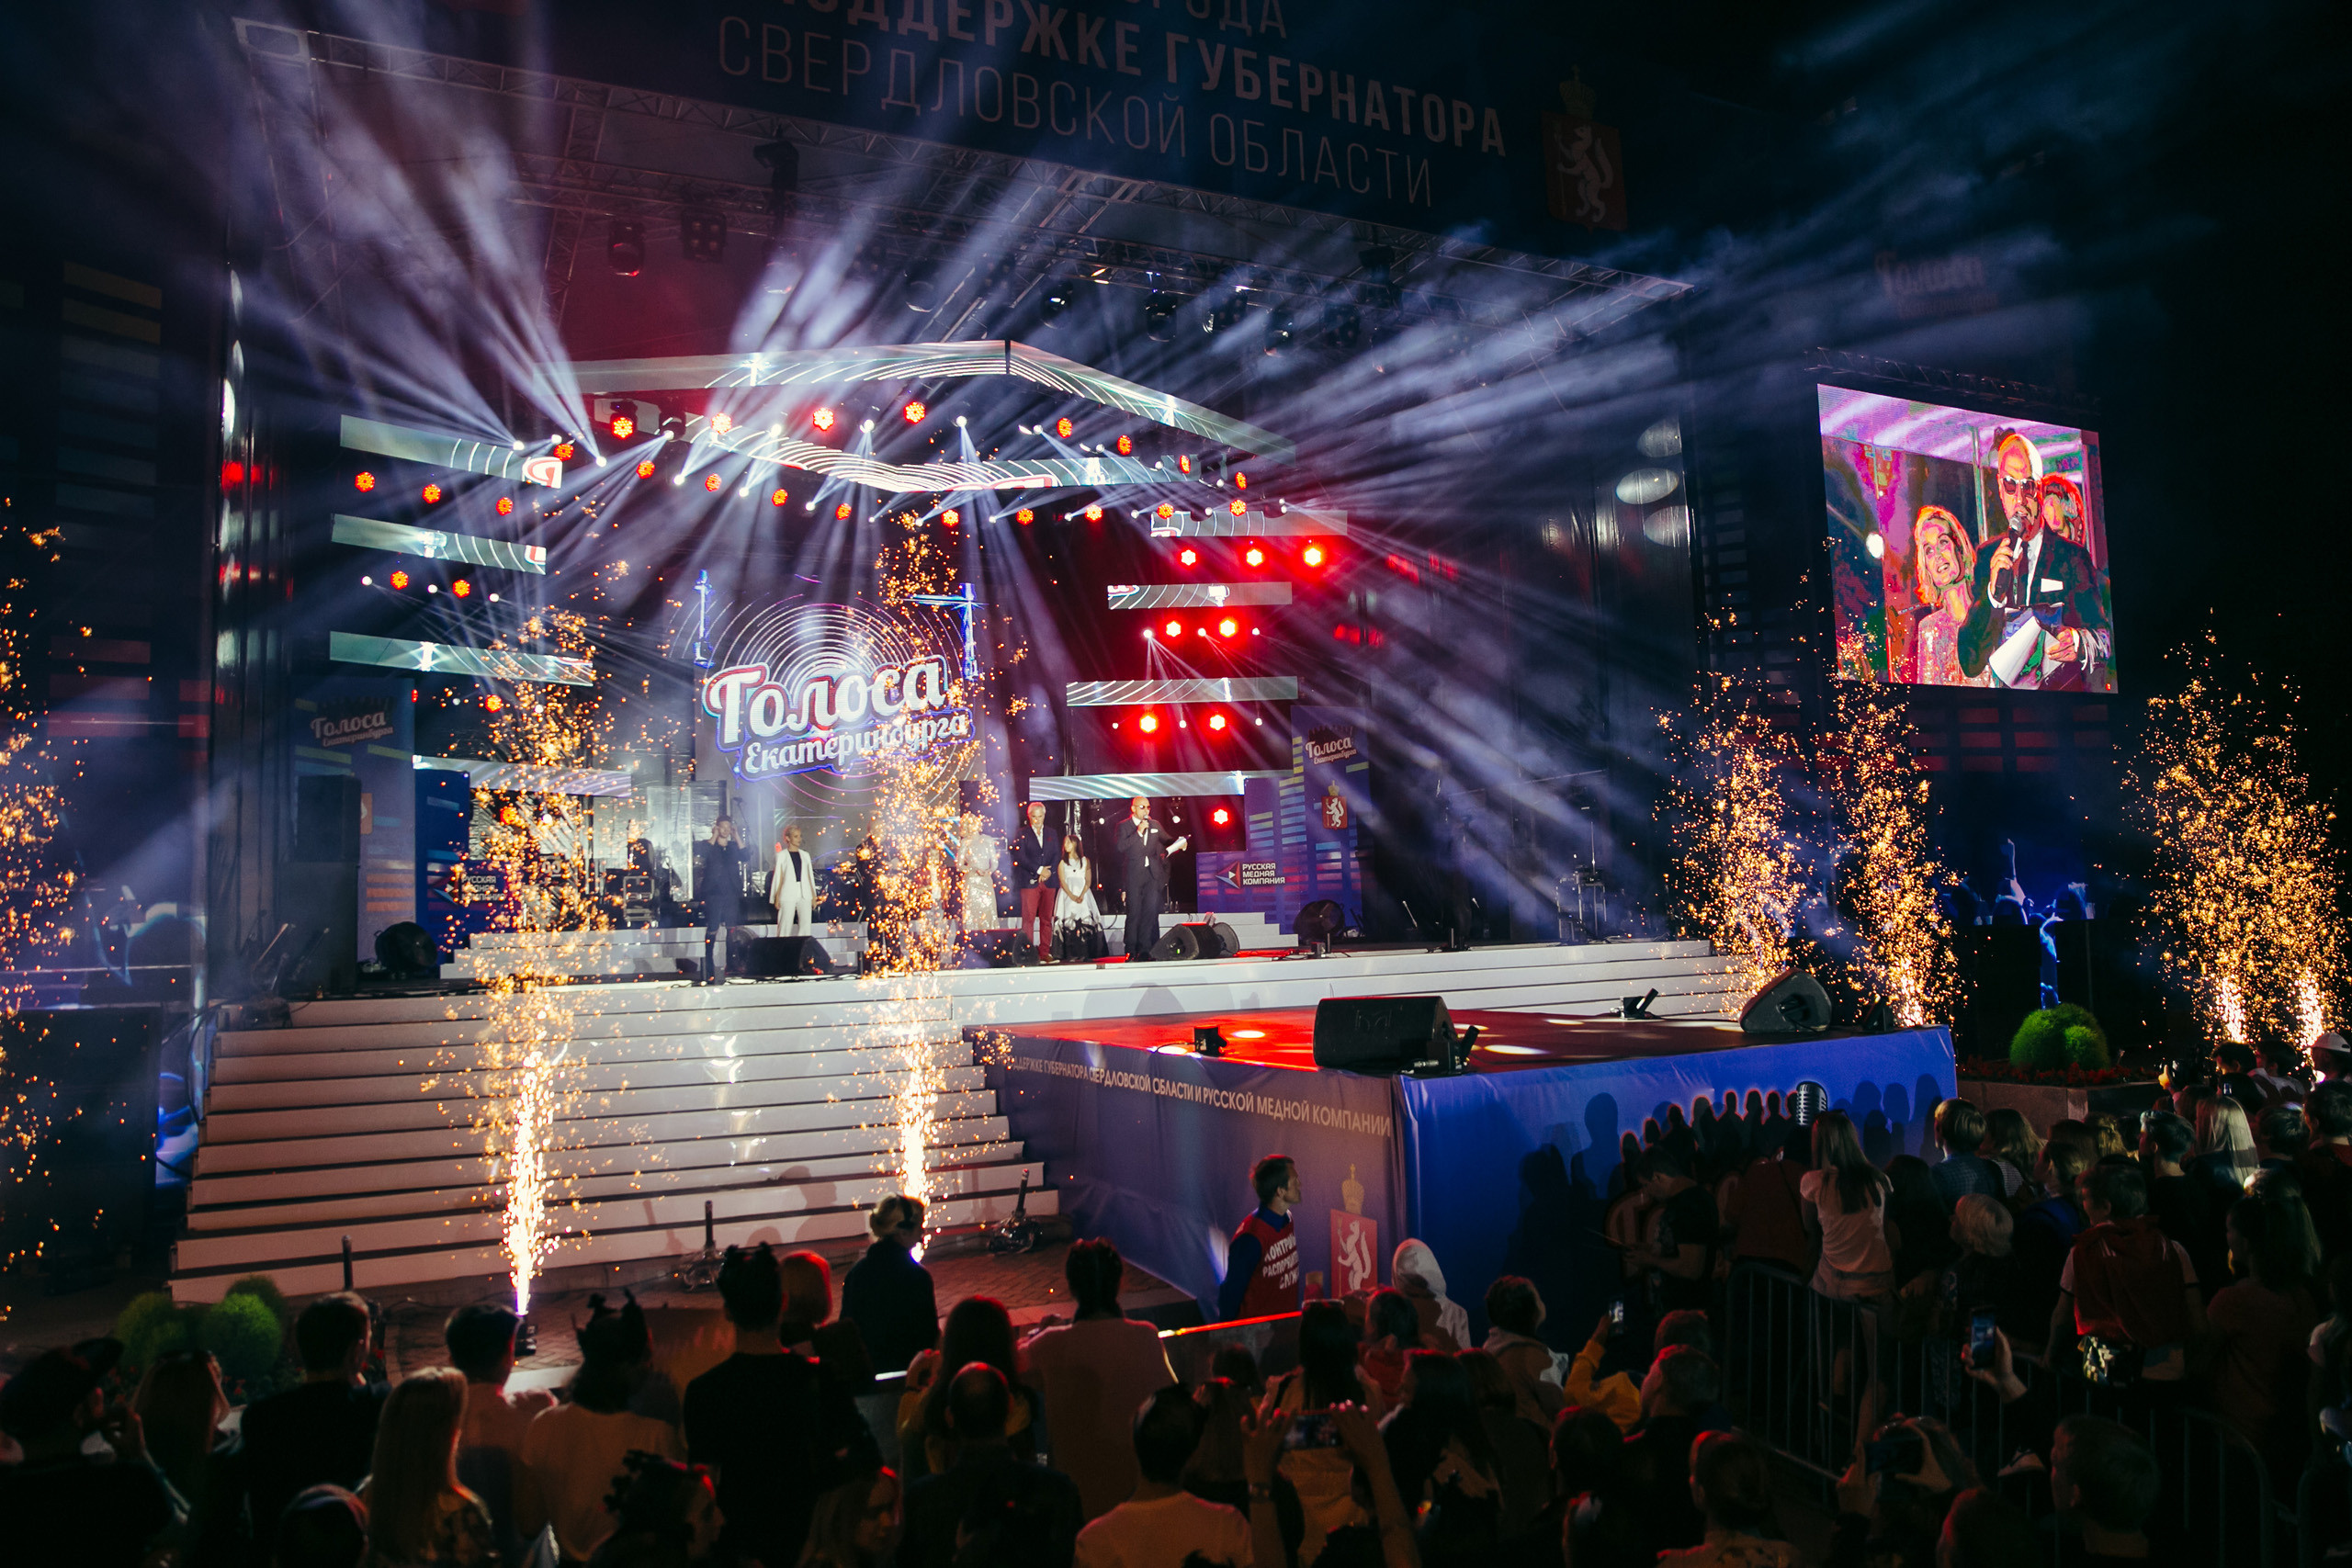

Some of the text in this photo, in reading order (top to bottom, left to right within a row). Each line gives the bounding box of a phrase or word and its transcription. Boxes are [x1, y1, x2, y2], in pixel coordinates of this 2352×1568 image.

[781, 0, 1507, 157] ДДЕРЖКЕ ГУБЕРНАТОРА
[718, 16, 1432, 209] СВЕРДЛОВСКОЙ ОБЛАСТИ
[709, 660, 946, 744] Голоса
[310, 711, 386, 739] Голоса
[1305, 737, 1352, 759] Голоса
[1242, 863, 1276, 871] РУССКАЯ
[1242, 870, 1275, 878] МЕДНАЯ
[1242, 876, 1286, 886] КОМПАНИЯ
[1152, 1079, 1194, 1101] ОБЛАСТИ
[1195, 1085, 1202, 1102] И
[1203, 1089, 1254, 1113] РУССКОЙ
[1257, 1095, 1310, 1122] МЕДНОЙ
[1313, 1104, 1391, 1137] КОМПАНИИ
